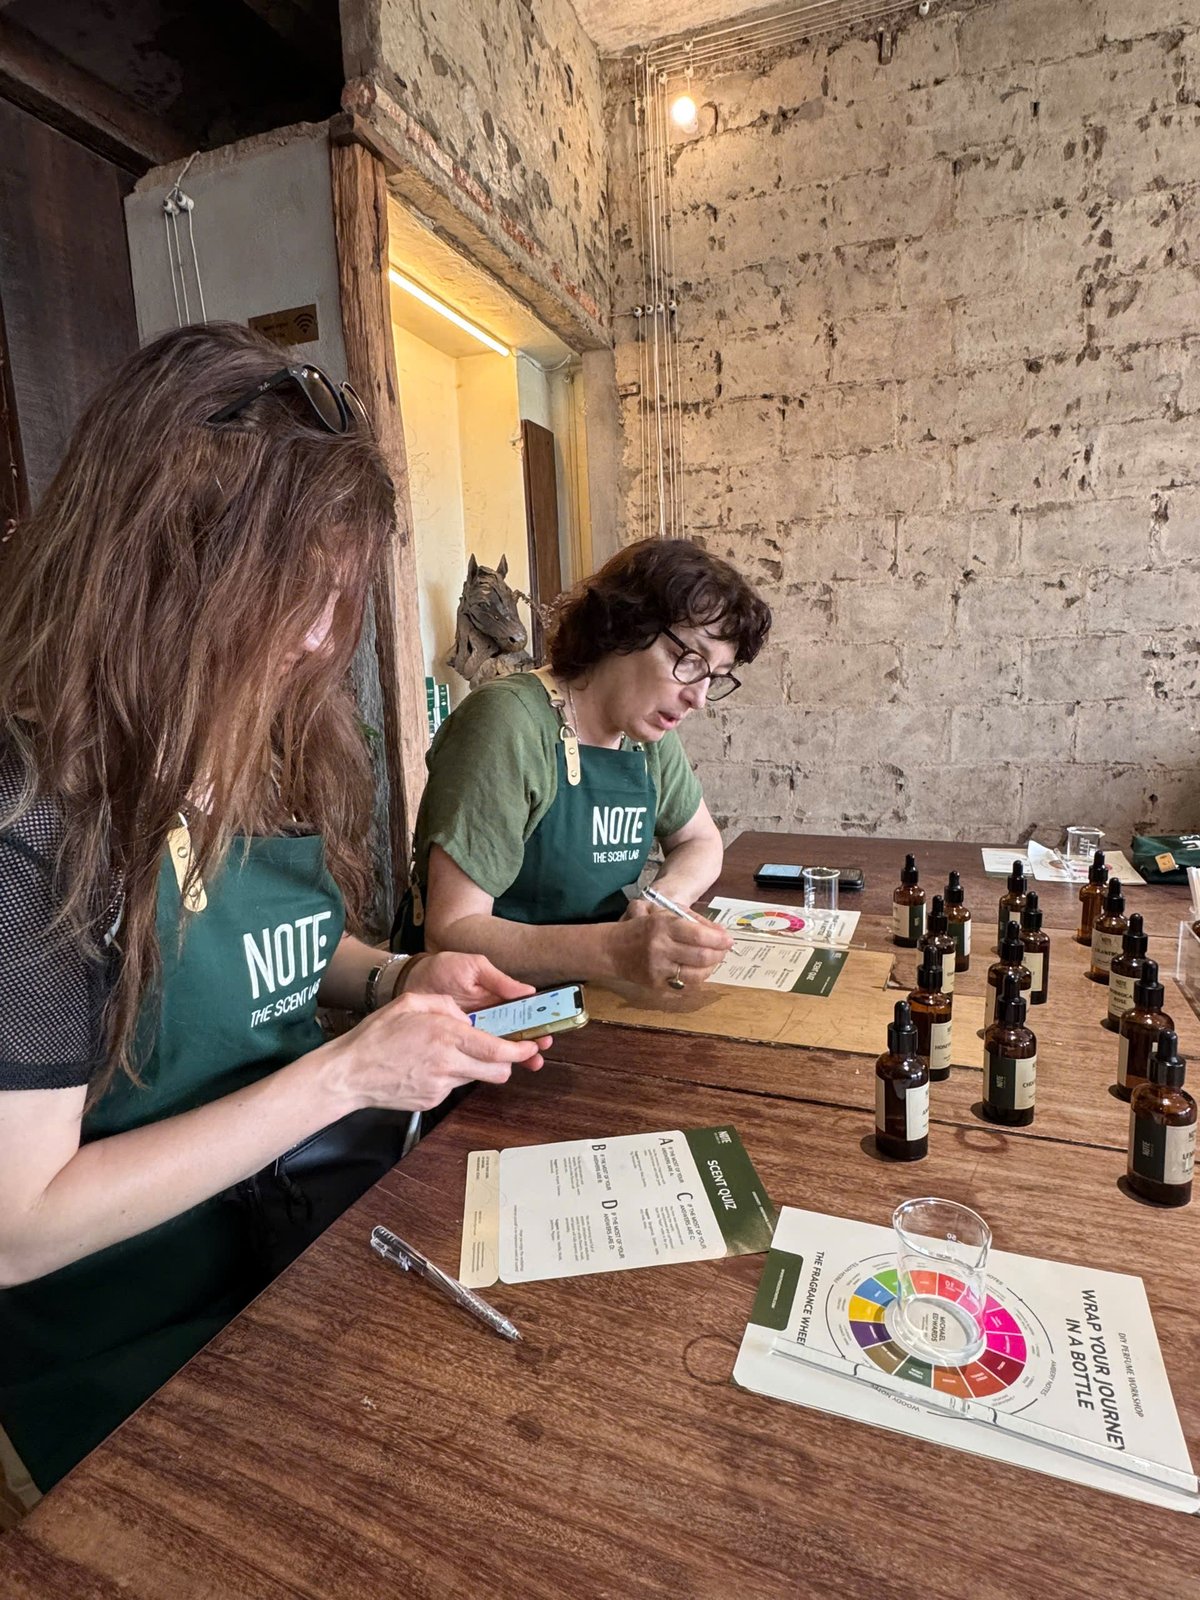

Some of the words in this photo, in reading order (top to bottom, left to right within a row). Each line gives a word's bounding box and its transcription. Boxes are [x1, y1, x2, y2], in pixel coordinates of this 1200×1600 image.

[593, 806, 647, 846] NOTE
[592, 852, 607, 863] THE
[608, 850, 628, 862] SCENT
[628, 849, 640, 860] LAB
[243, 910, 332, 1000] NOTE
[250, 1004, 274, 1028] THE
[274, 986, 308, 1016] SCENT
[308, 978, 321, 1000] LAB
[592, 1144, 607, 1152] B
[658, 1136, 674, 1146] A
[662, 1147, 671, 1164] ANSWERS
[671, 1157, 679, 1167] MOST
[706, 1159, 727, 1187] SCENT
[717, 1187, 737, 1210] QUIZ
[602, 1200, 619, 1210] D
[677, 1192, 694, 1201] C
[604, 1213, 612, 1234] ANSWERS
[680, 1204, 691, 1225] ANSWERS
[692, 1216, 700, 1228] MOST
[698, 1236, 707, 1248] YOUR
[618, 1245, 626, 1258] YOUR
[814, 1251, 824, 1266] THE
[844, 1262, 859, 1272] NOTES
[803, 1266, 822, 1315] FRAGRANCE
[1081, 1288, 1102, 1331] WRAP
[931, 1313, 939, 1342] EDWARDS
[1065, 1319, 1081, 1333] IN
[1068, 1336, 1082, 1346] A
[1118, 1332, 1127, 1343] DIY
[1088, 1335, 1110, 1376] YOUR
[1120, 1344, 1135, 1375] PERFUME
[1040, 1379, 1054, 1397] NOTES
[1069, 1351, 1094, 1410] BOTTLE
[892, 1397, 920, 1412] WOODY
[1128, 1376, 1144, 1416] WORKSHOP
